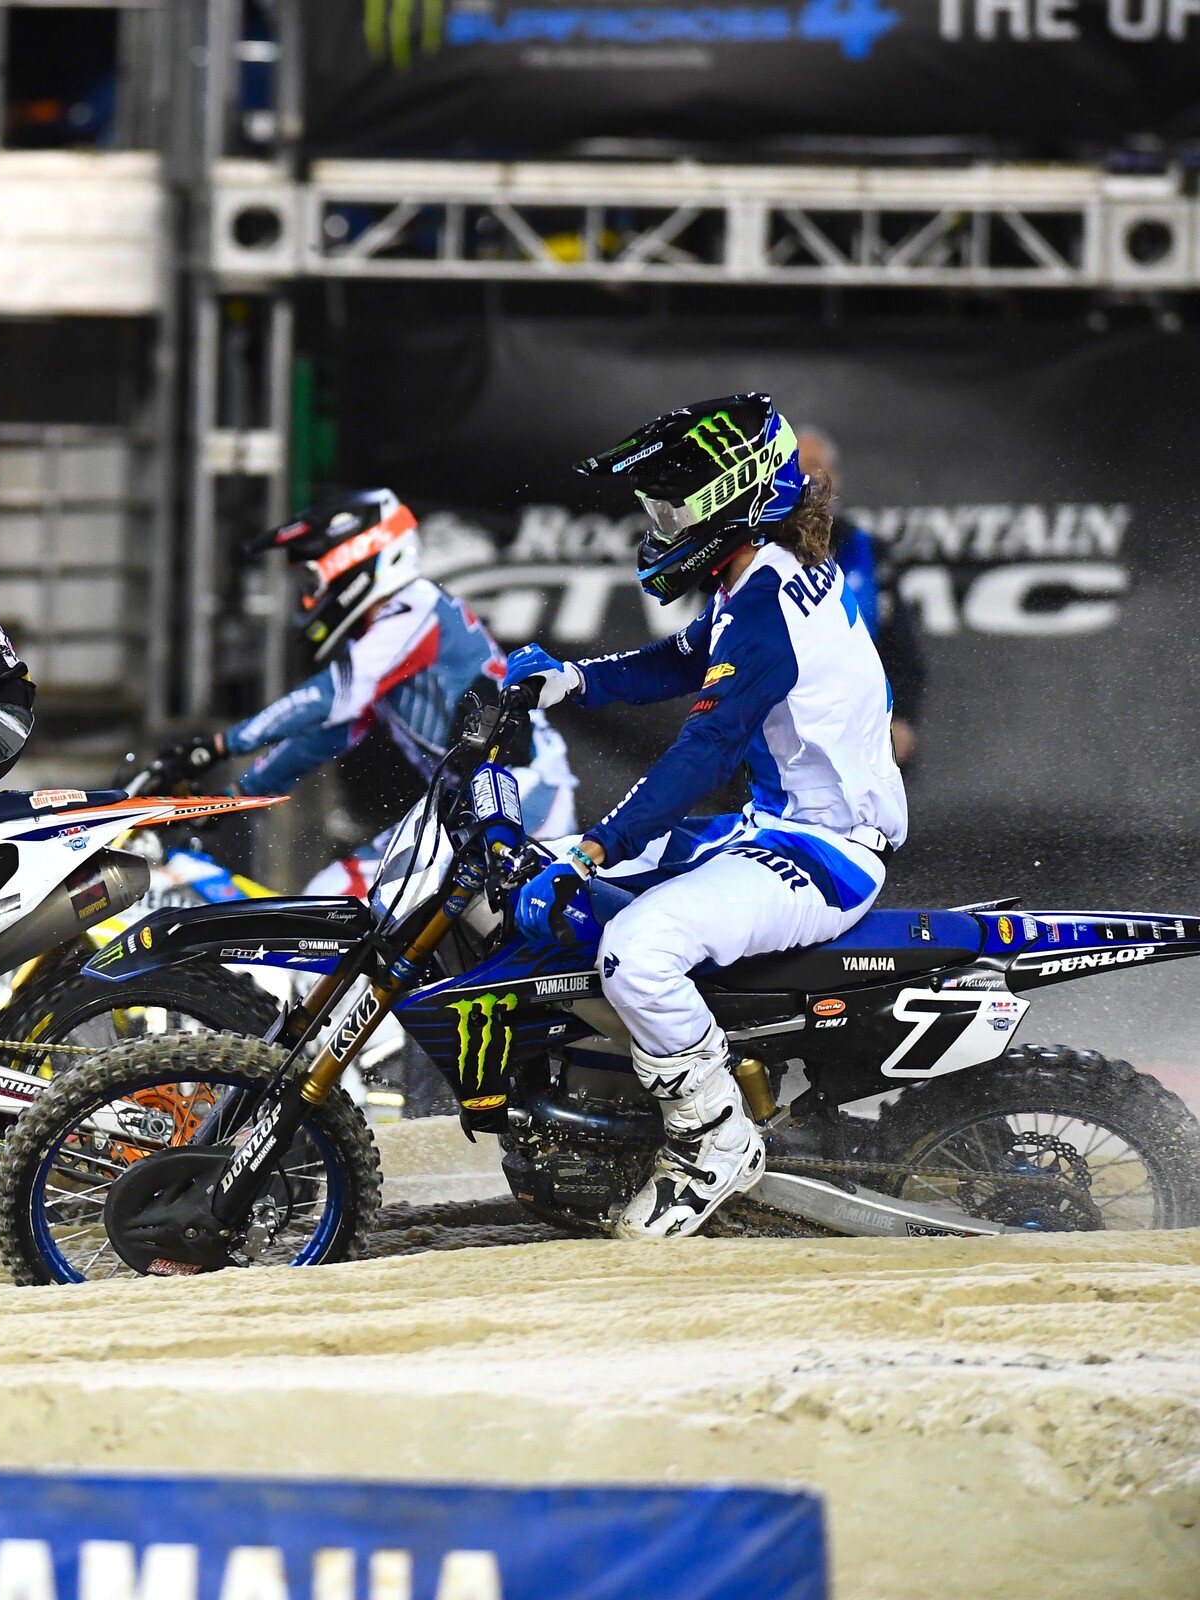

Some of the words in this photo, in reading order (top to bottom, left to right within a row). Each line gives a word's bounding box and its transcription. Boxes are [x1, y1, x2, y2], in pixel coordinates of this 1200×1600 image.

[695, 440, 785, 518] 100%
[681, 537, 723, 573] MONSTER
[57, 825, 88, 839] AMA
[326, 910, 357, 924] Plessinger
[999, 916, 1013, 944] FMF
[308, 941, 339, 950] YAMAHA
[842, 957, 896, 971] YAMAHA
[1039, 946, 1155, 977] DUNLOP
[535, 976, 590, 995] YAMALUBE
[959, 975, 1004, 992] Plessinger
[328, 989, 380, 1063] KYB
[892, 999, 982, 1070] 7
[464, 1095, 506, 1108] FMF
[220, 1102, 283, 1194] DUNLOP
[250, 1135, 278, 1173] BRAKING
[832, 1204, 896, 1231] YAMALUBE
